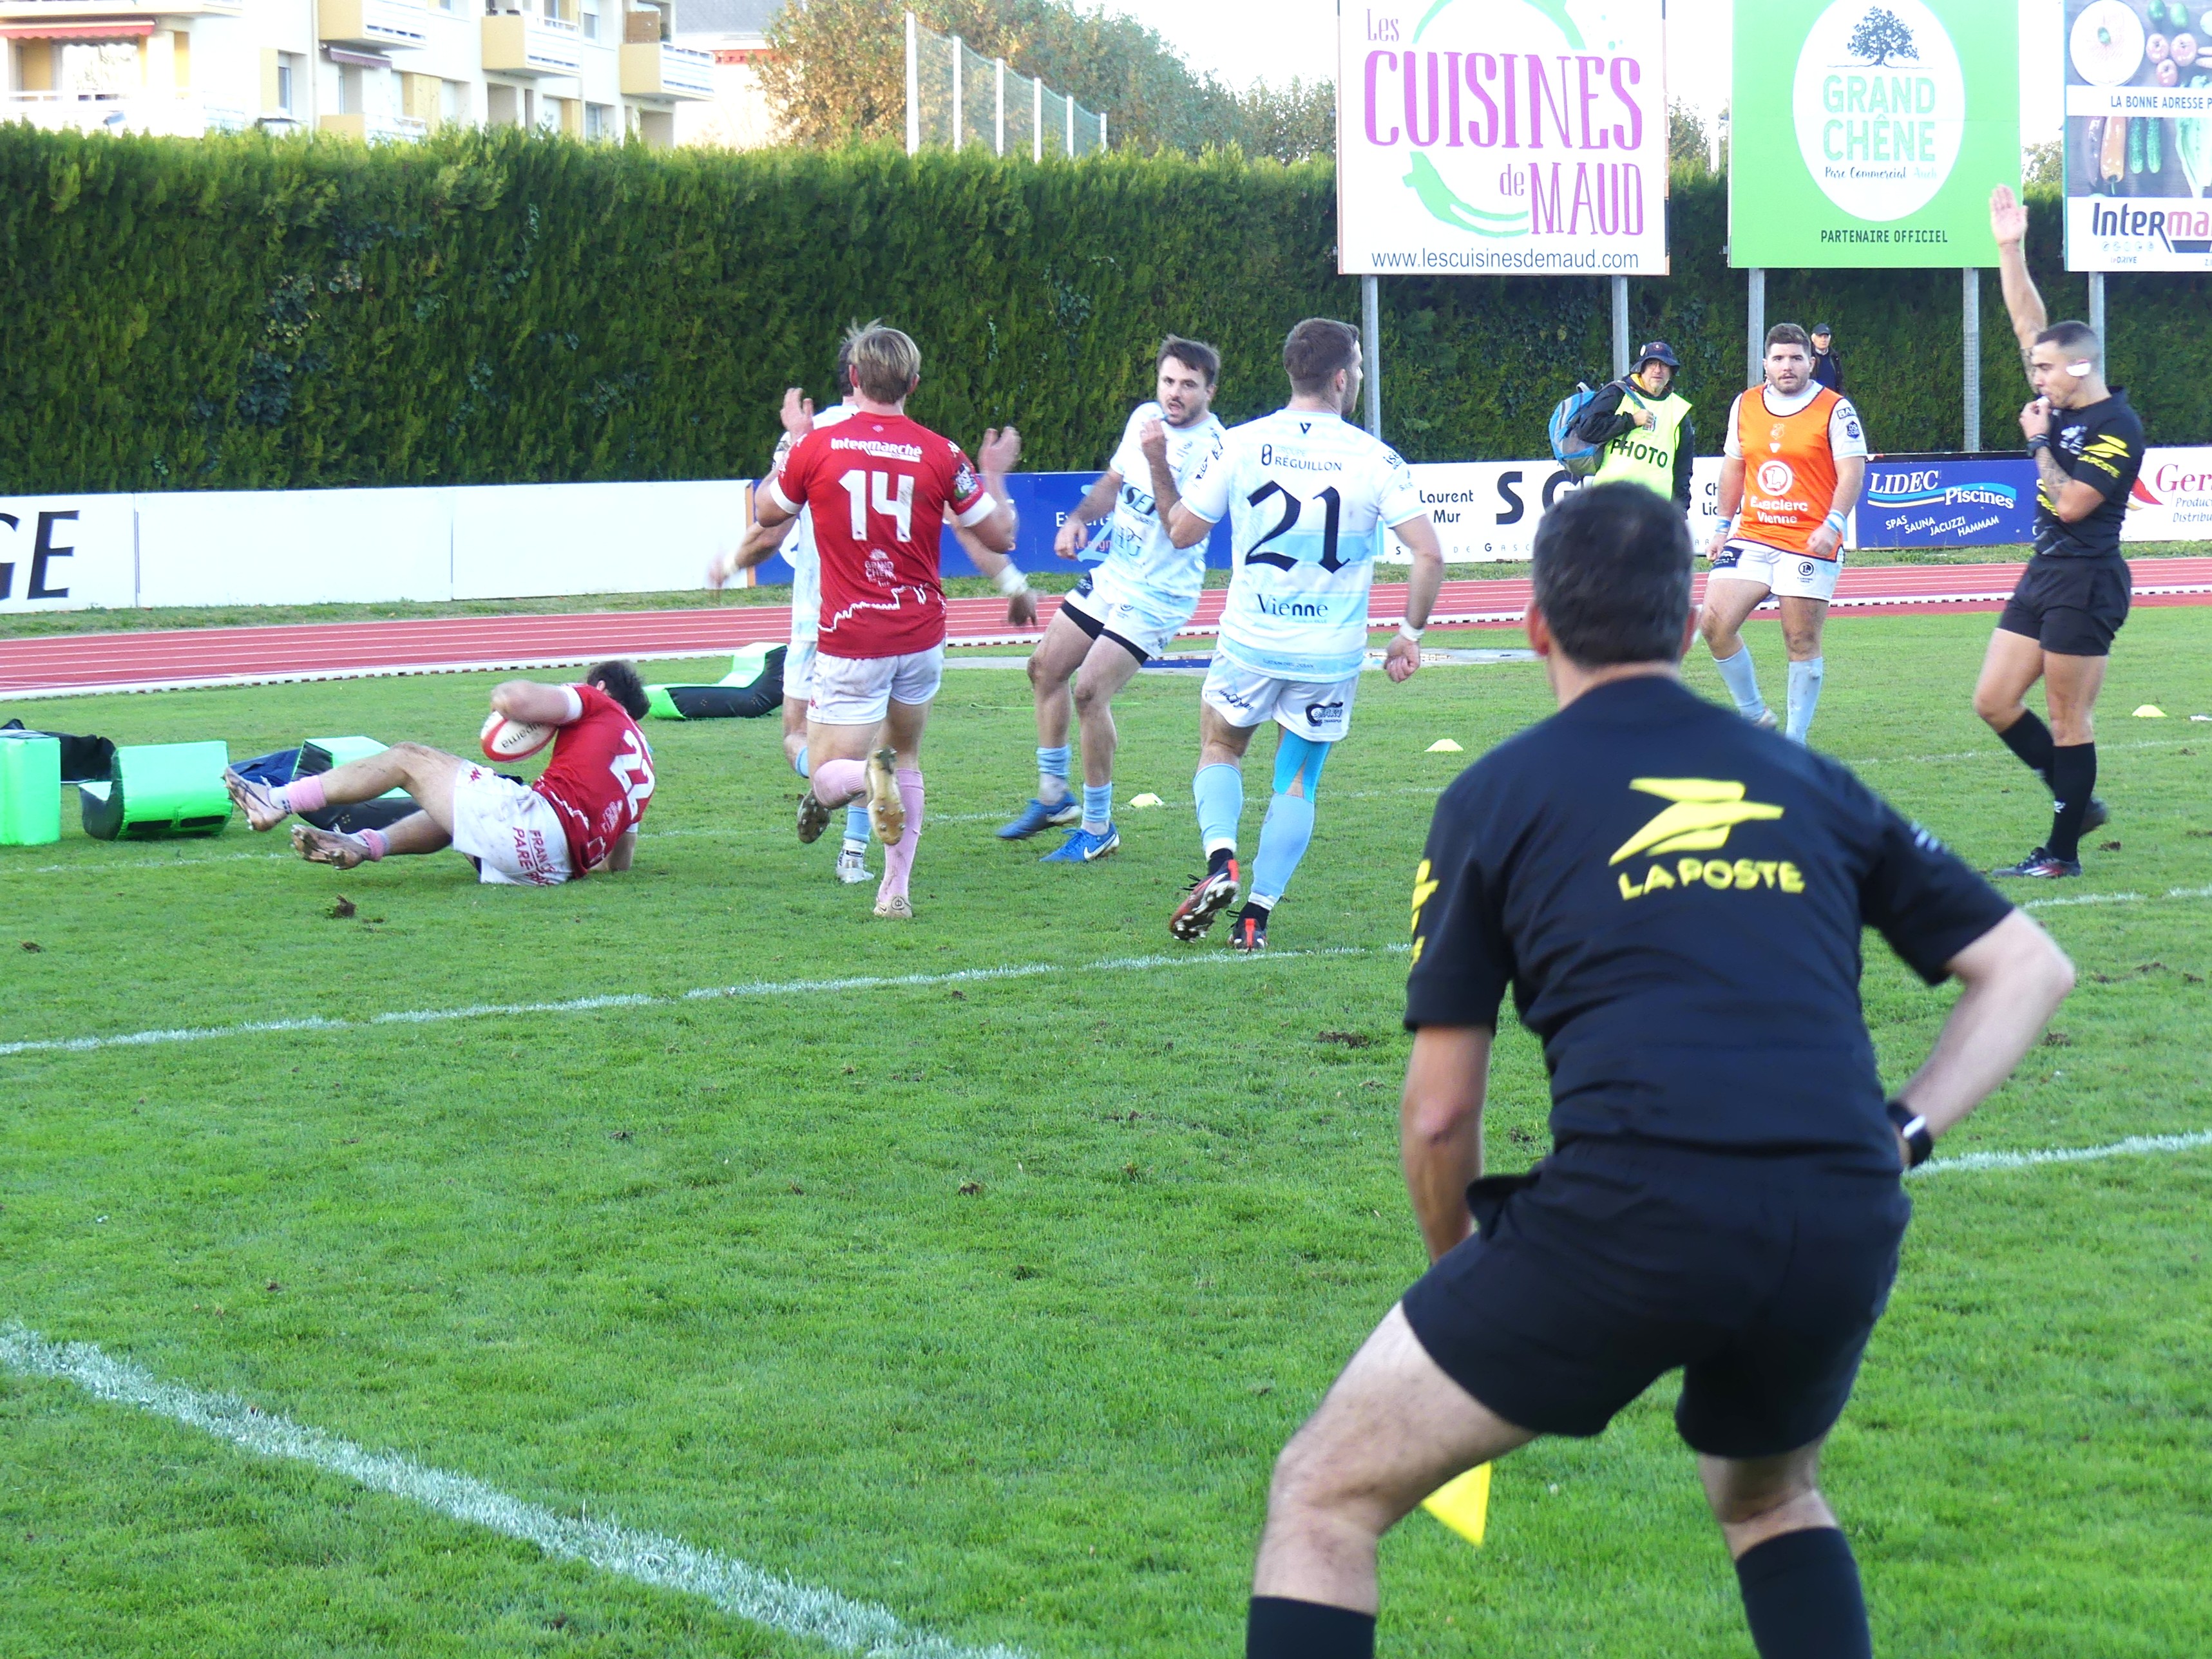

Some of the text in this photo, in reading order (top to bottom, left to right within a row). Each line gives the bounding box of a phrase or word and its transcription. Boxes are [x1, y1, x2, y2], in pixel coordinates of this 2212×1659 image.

[1367, 8, 1399, 42] Les
[1365, 50, 1642, 150] CUISINES
[1823, 75, 1935, 113] GRAND
[2110, 96, 2122, 108] LA
[2126, 96, 2158, 108] BONNE
[2162, 97, 2204, 109] ADRESSE
[1824, 113, 1935, 161] CHÊNE
[1826, 166, 1845, 178] Parc
[1850, 166, 1907, 179] Commercial
[1500, 162, 1643, 236] de MAUD
[1821, 230, 1948, 243] PARTENAIRE OFFICIEL
[2092, 203, 2212, 253] Interma
[1372, 249, 1639, 268] www.lescuisinesdemaud.com
[1275, 455, 1342, 471] RÉGUILLON
[1610, 439, 1668, 468] PHOTO
[1869, 470, 1939, 495] LIDEC
[2156, 464, 2212, 493] Ger
[839, 469, 915, 543] 14
[1419, 489, 1474, 503] Laurent
[1945, 486, 2014, 509] Piscines
[2175, 497, 2212, 507] Produc
[1245, 480, 1350, 574] 21
[1433, 509, 1461, 523] Mur
[1757, 511, 1798, 524] Vienne
[1885, 515, 1908, 530] SPAS
[1904, 517, 1936, 534] SAUNA
[1930, 516, 1966, 536] JACUZZI
[1958, 515, 1999, 536] HAMMAM
[1255, 593, 1328, 617] Vienne
[1618, 857, 1806, 900] LA POSTE
